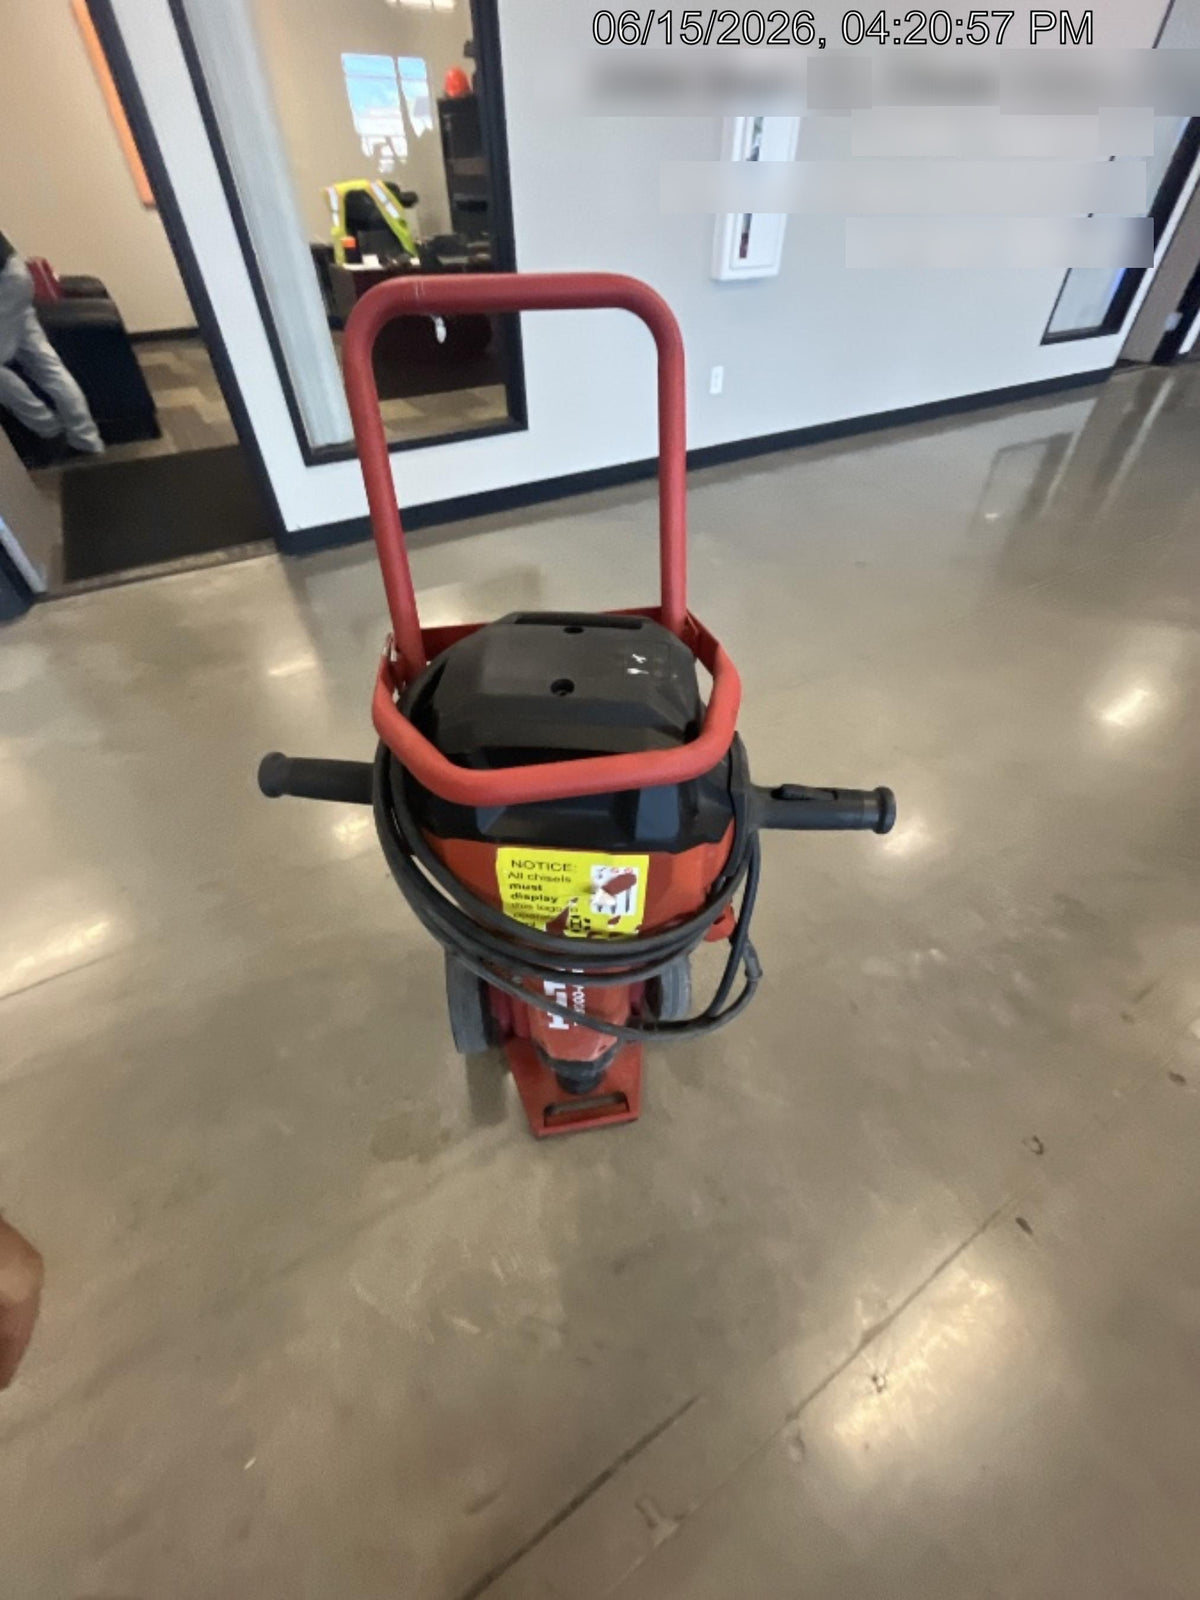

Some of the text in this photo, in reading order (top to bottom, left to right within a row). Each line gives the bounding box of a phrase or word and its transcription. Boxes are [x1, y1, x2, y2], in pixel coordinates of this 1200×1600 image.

[508, 871, 572, 883] All chisels
[509, 883, 543, 891] must
[511, 892, 558, 904] display
